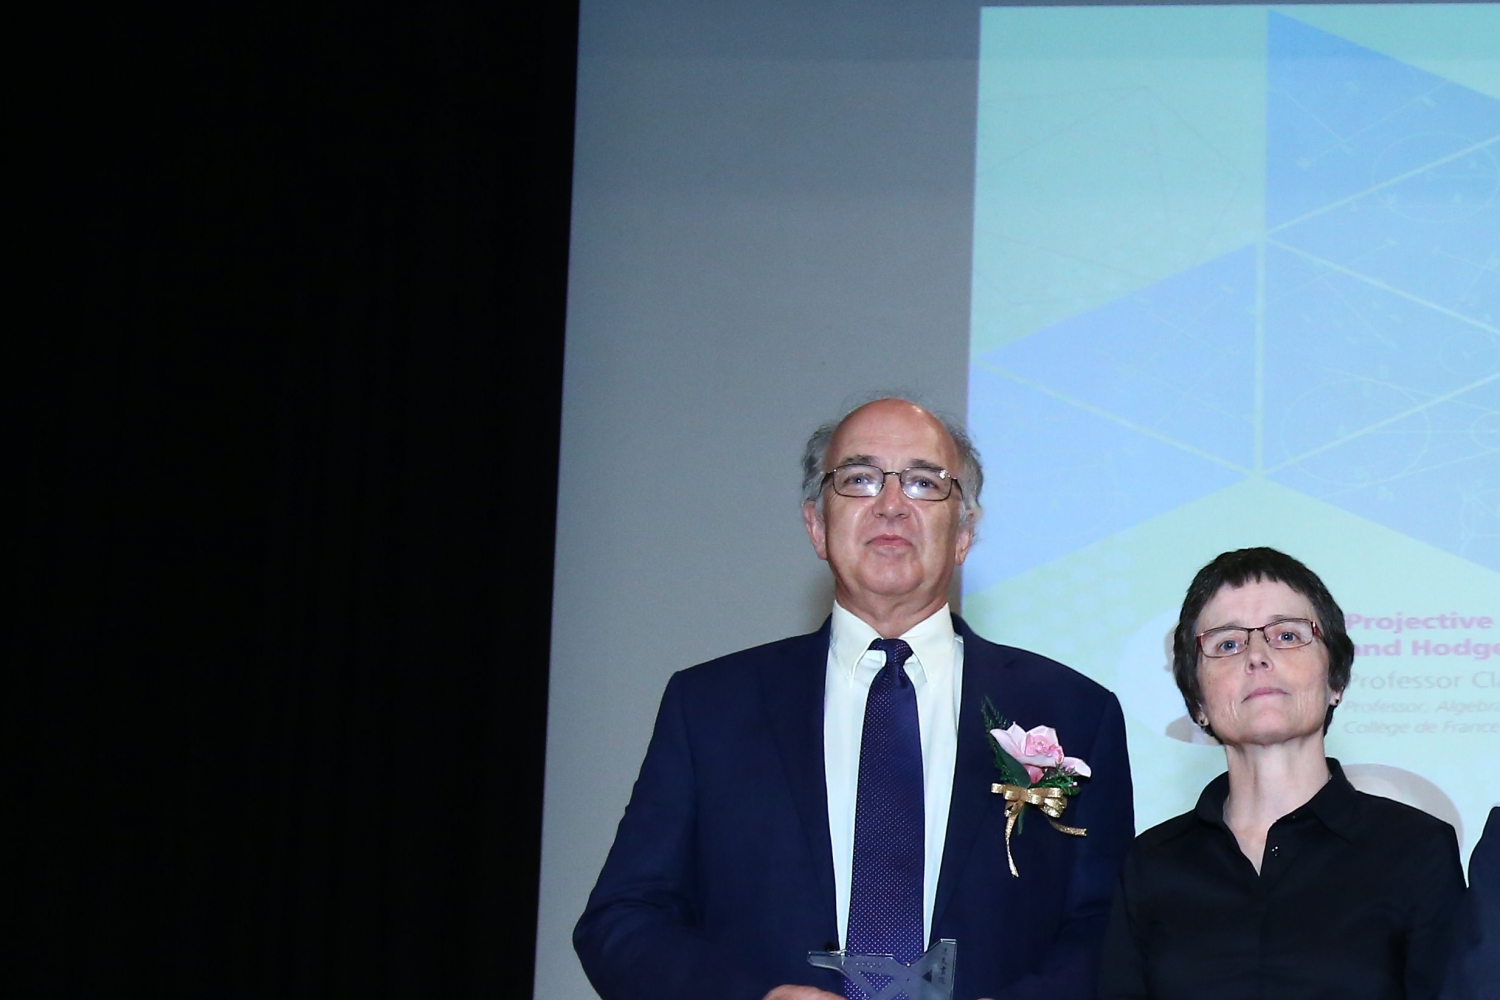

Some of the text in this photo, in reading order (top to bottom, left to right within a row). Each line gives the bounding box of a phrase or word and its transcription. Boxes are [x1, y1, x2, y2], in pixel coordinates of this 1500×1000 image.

[1344, 611, 1494, 634] Projective
[1414, 720, 1438, 733] de
[1443, 720, 1500, 733] France
